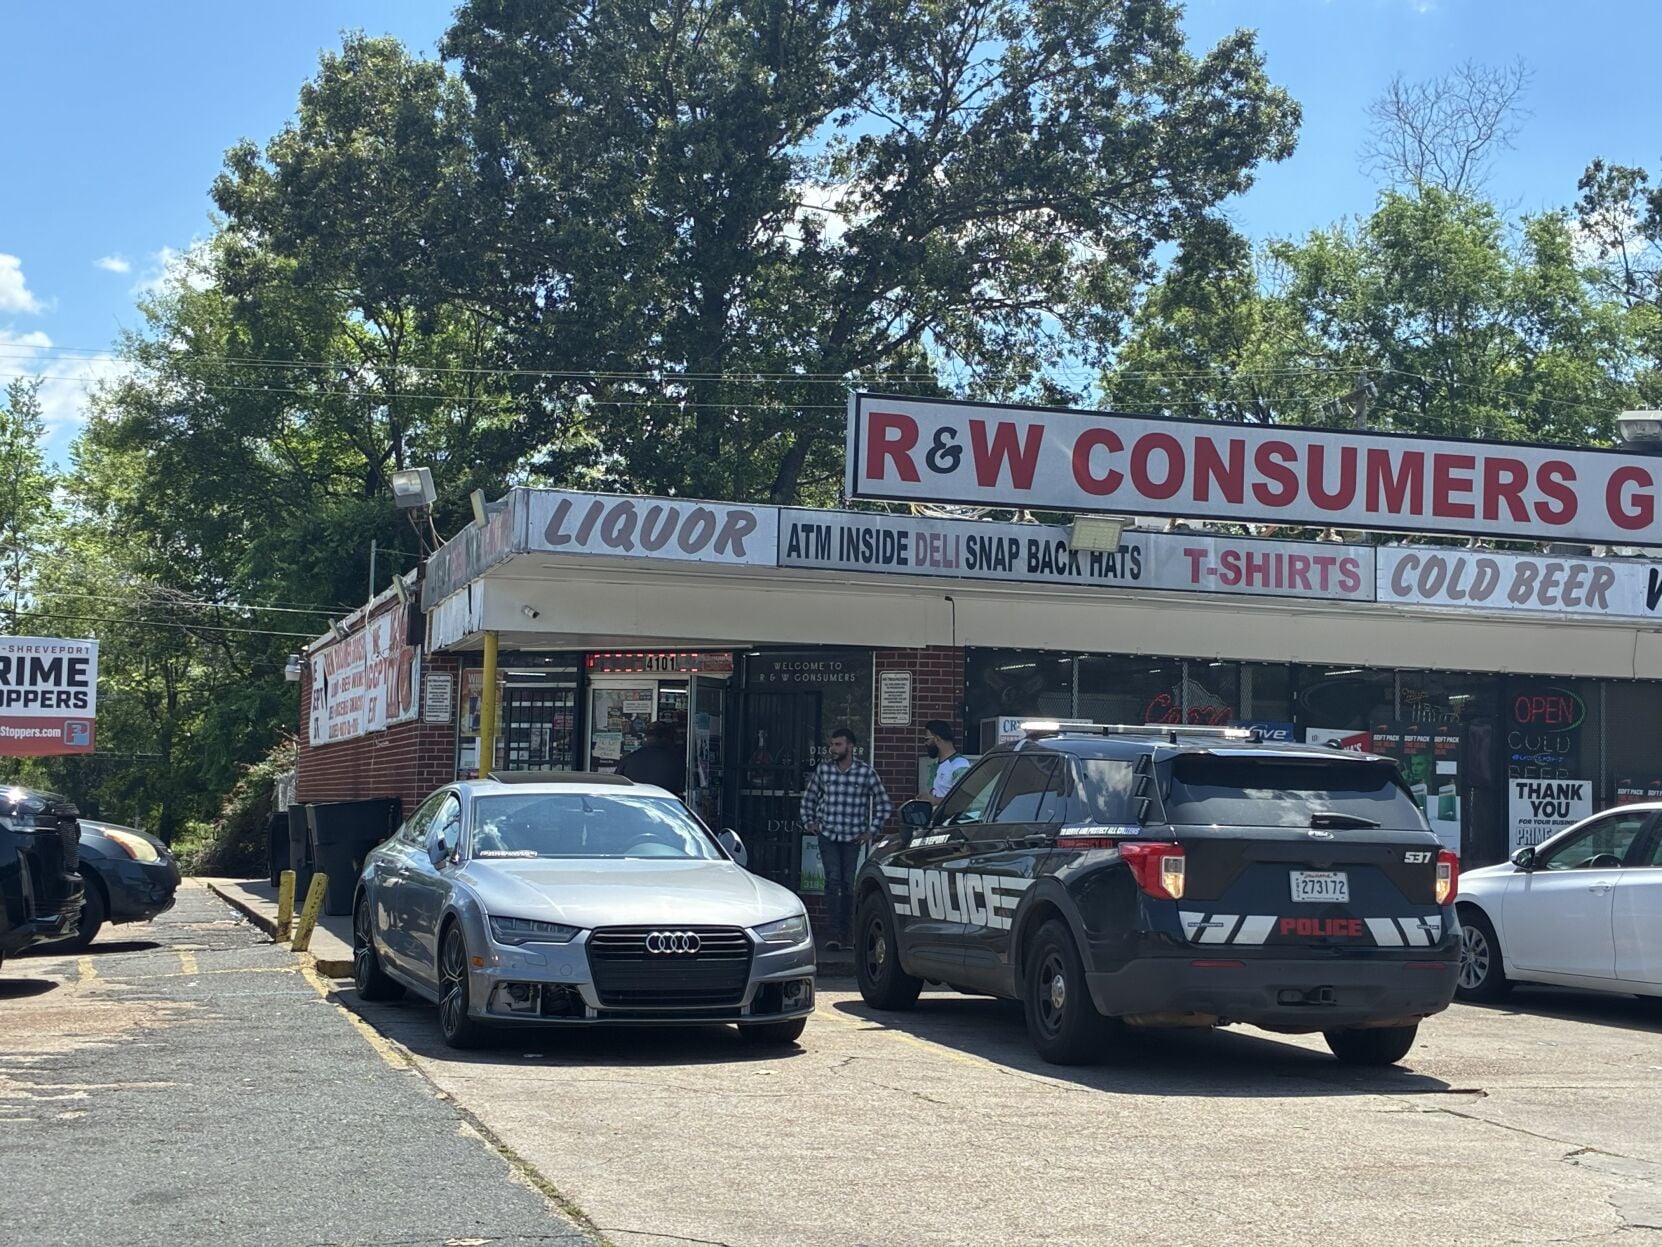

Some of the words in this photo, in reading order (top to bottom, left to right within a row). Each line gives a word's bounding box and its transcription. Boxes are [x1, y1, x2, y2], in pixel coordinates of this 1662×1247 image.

[866, 412, 1045, 490] R&W
[1072, 428, 1578, 526] CONSUMERS
[544, 498, 757, 558] LIQUOR
[786, 523, 832, 560] ATM
[839, 526, 909, 566] INSIDE
[915, 532, 961, 569] DELI
[965, 534, 1020, 572] SNAP
[1027, 538, 1082, 577] BACK
[1089, 544, 1142, 580] HATS
[1183, 548, 1362, 594] T-SHIRTS
[1391, 553, 1501, 602] COLD
[1507, 560, 1616, 610] BEER
[646, 655, 677, 672] 4101
[773, 661, 825, 671] WELCOME
[830, 662, 842, 671] TO
[759, 674, 765, 682] R
[794, 674, 857, 683] CONSUMERS
[1514, 695, 1574, 725] OPEN
[809, 746, 864, 756] DISCER
[1516, 783, 1584, 801] THANK
[1529, 801, 1571, 819] YOU
[1403, 851, 1432, 864] 537
[1302, 880, 1347, 895] 273172
[908, 868, 1022, 931] POLICE
[1279, 917, 1363, 937] POLICE
